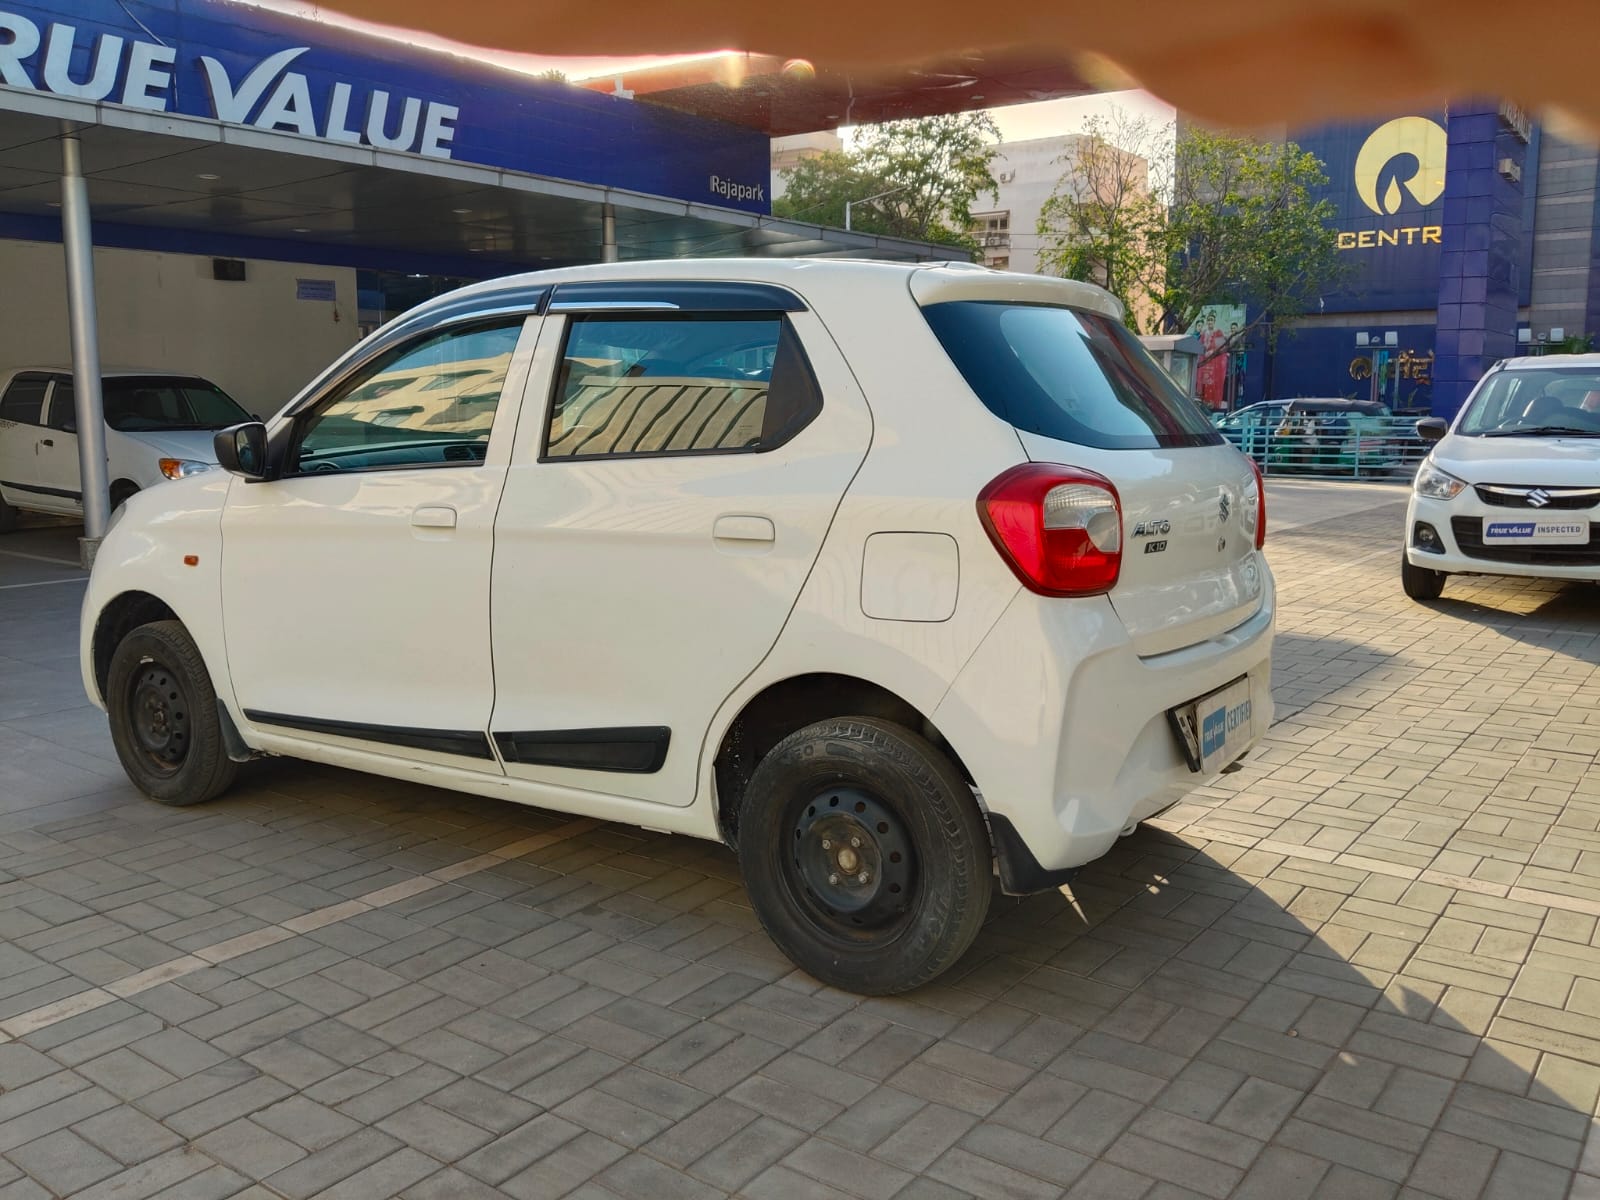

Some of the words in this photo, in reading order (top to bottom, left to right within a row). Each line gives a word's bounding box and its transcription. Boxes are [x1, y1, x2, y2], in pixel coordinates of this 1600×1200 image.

[201, 47, 459, 159] VALUE
[710, 175, 764, 202] Rajapark
[1337, 225, 1442, 249] CENTR
[1131, 520, 1170, 537] ALTO
[1508, 526, 1533, 534] VALUE
[1537, 526, 1581, 534] INSPECTED
[1146, 541, 1167, 553] K10
